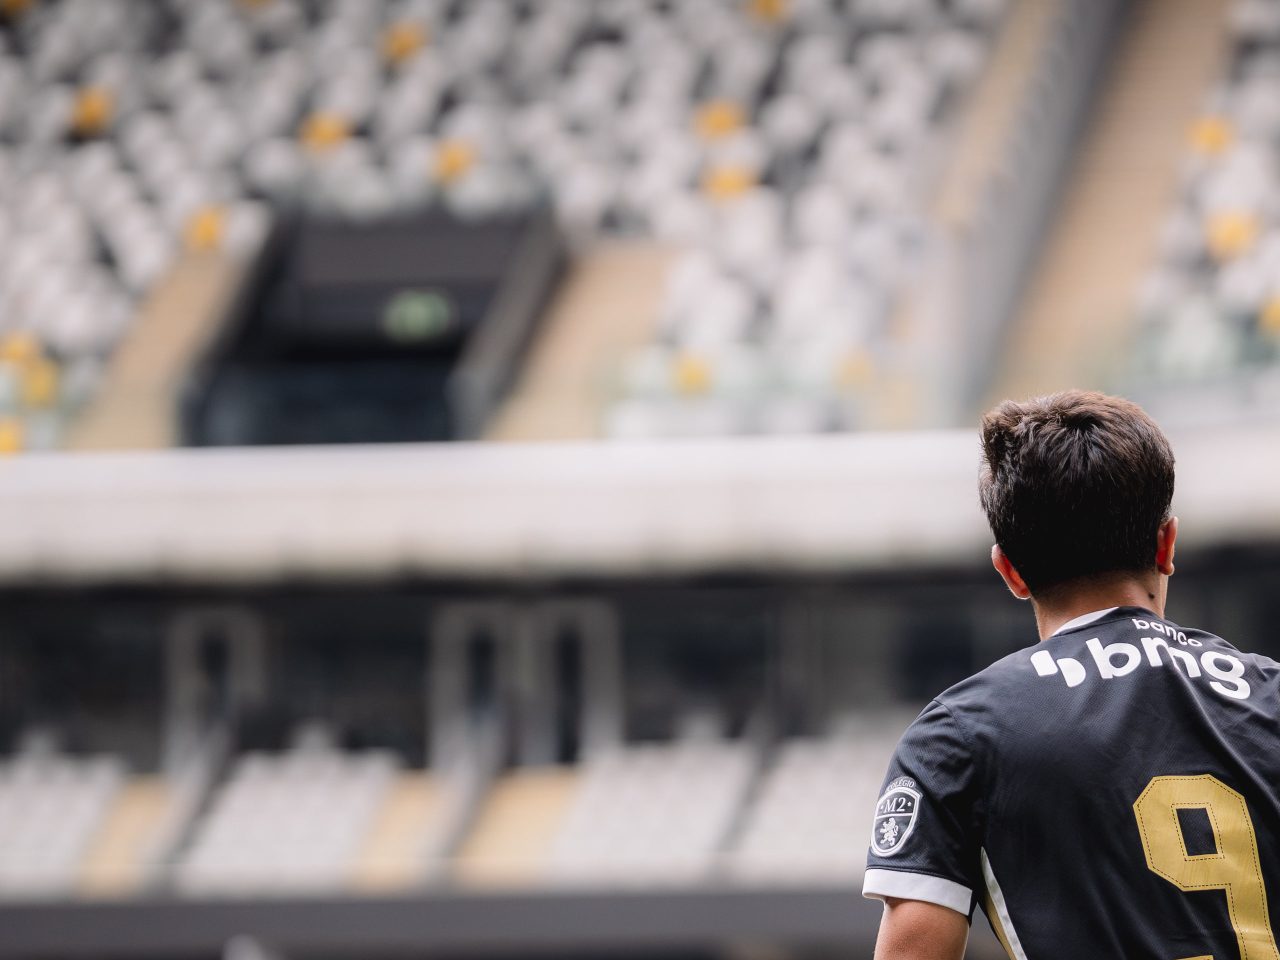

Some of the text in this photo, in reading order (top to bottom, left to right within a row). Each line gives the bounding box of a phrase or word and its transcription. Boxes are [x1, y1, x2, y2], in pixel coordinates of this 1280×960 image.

[1132, 619, 1203, 647] banco
[1085, 636, 1251, 700] bmg
[884, 797, 906, 812] M2
